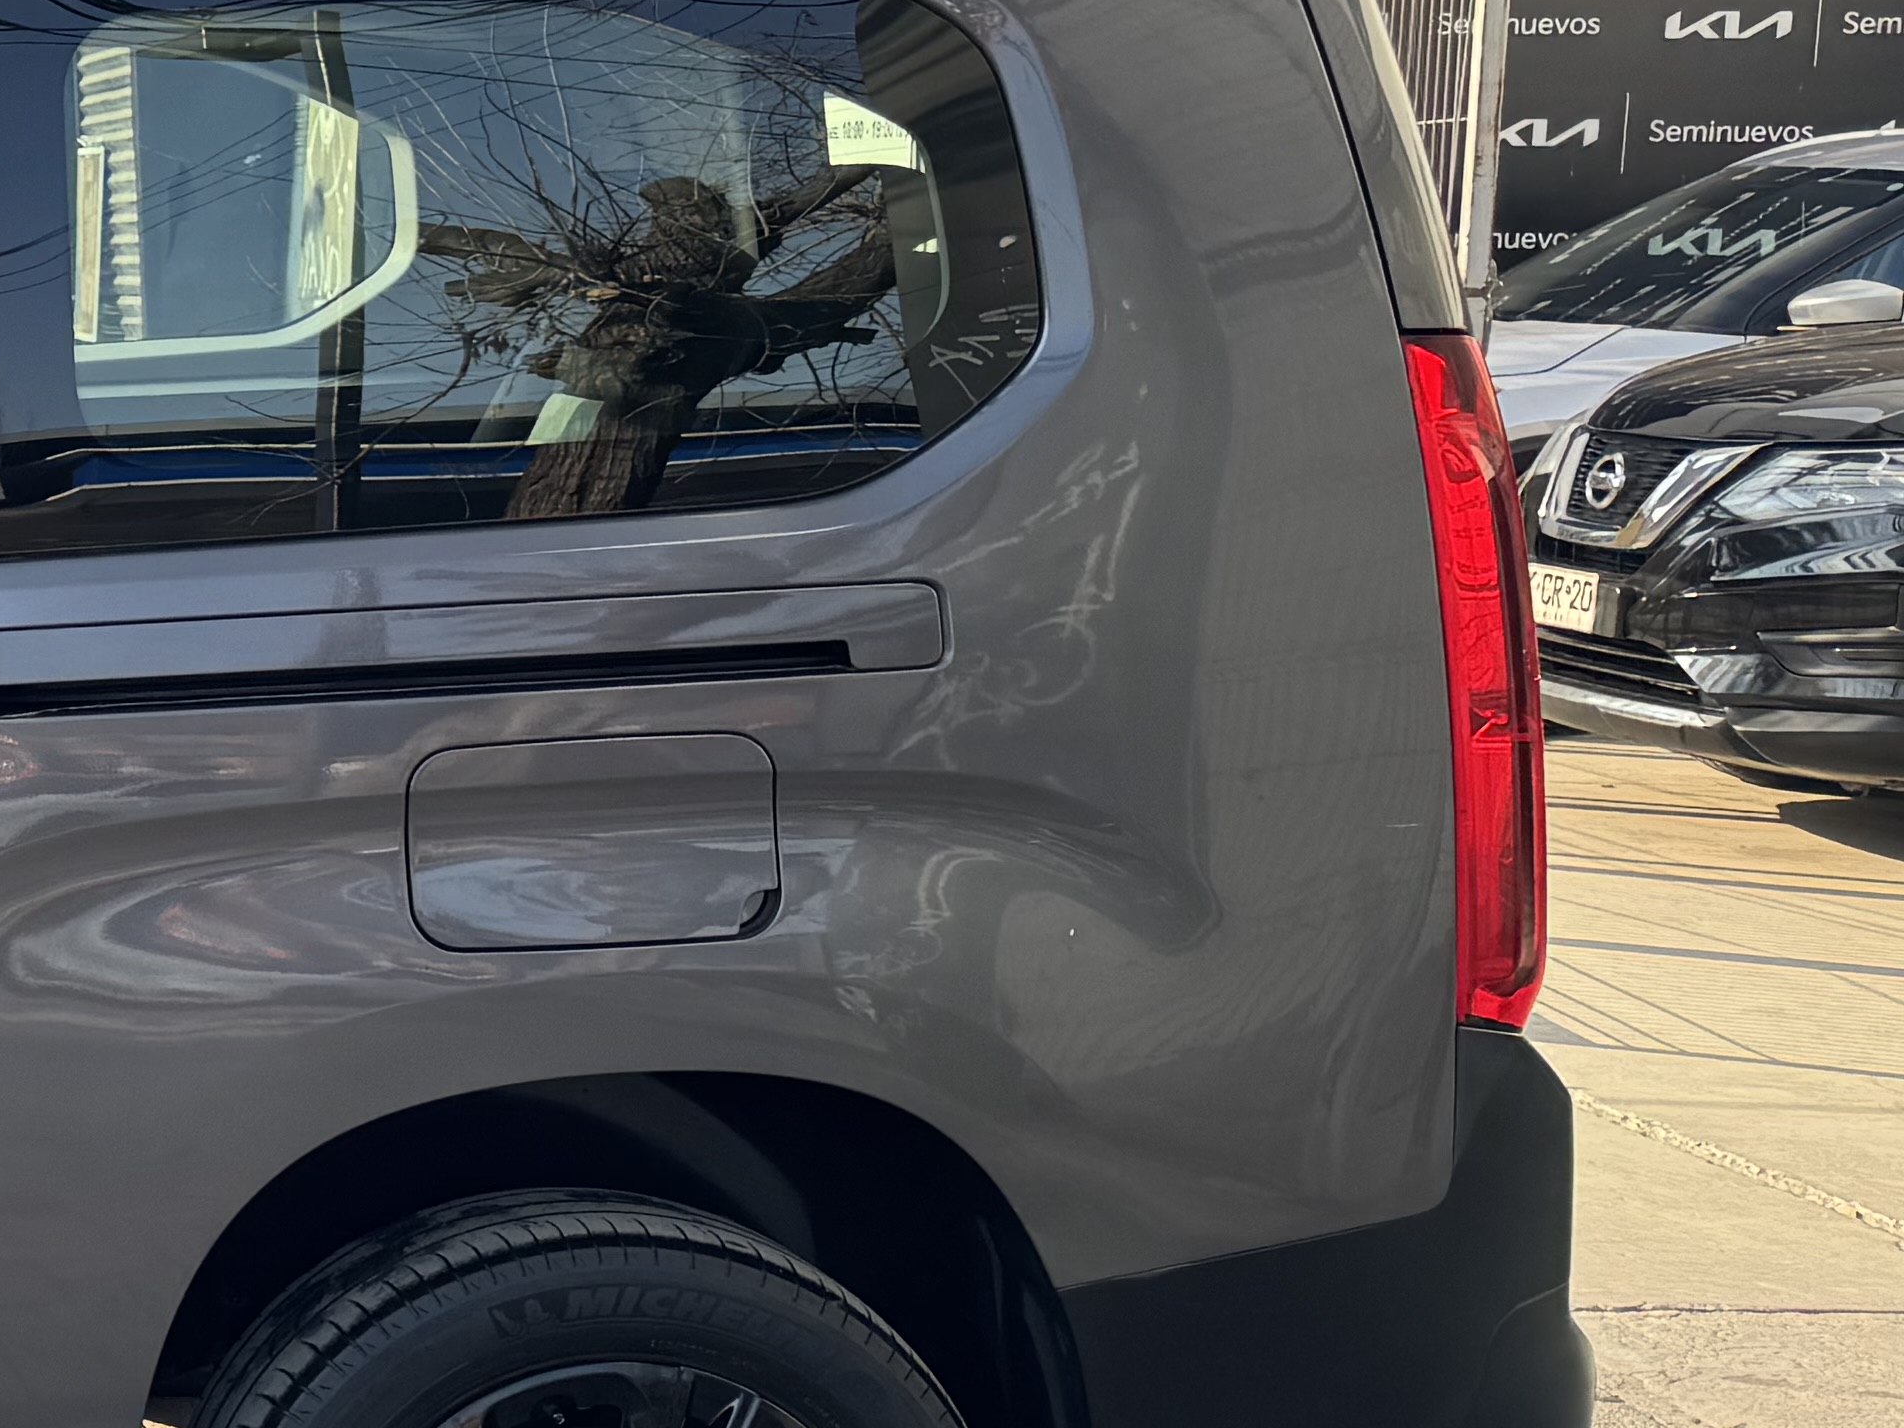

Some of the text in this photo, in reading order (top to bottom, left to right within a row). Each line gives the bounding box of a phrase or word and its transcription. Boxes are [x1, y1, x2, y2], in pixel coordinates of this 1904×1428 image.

[1437, 12, 1601, 37] Senuevos
[1664, 10, 1793, 40] KIA
[1648, 118, 1814, 143] Seminuevos
